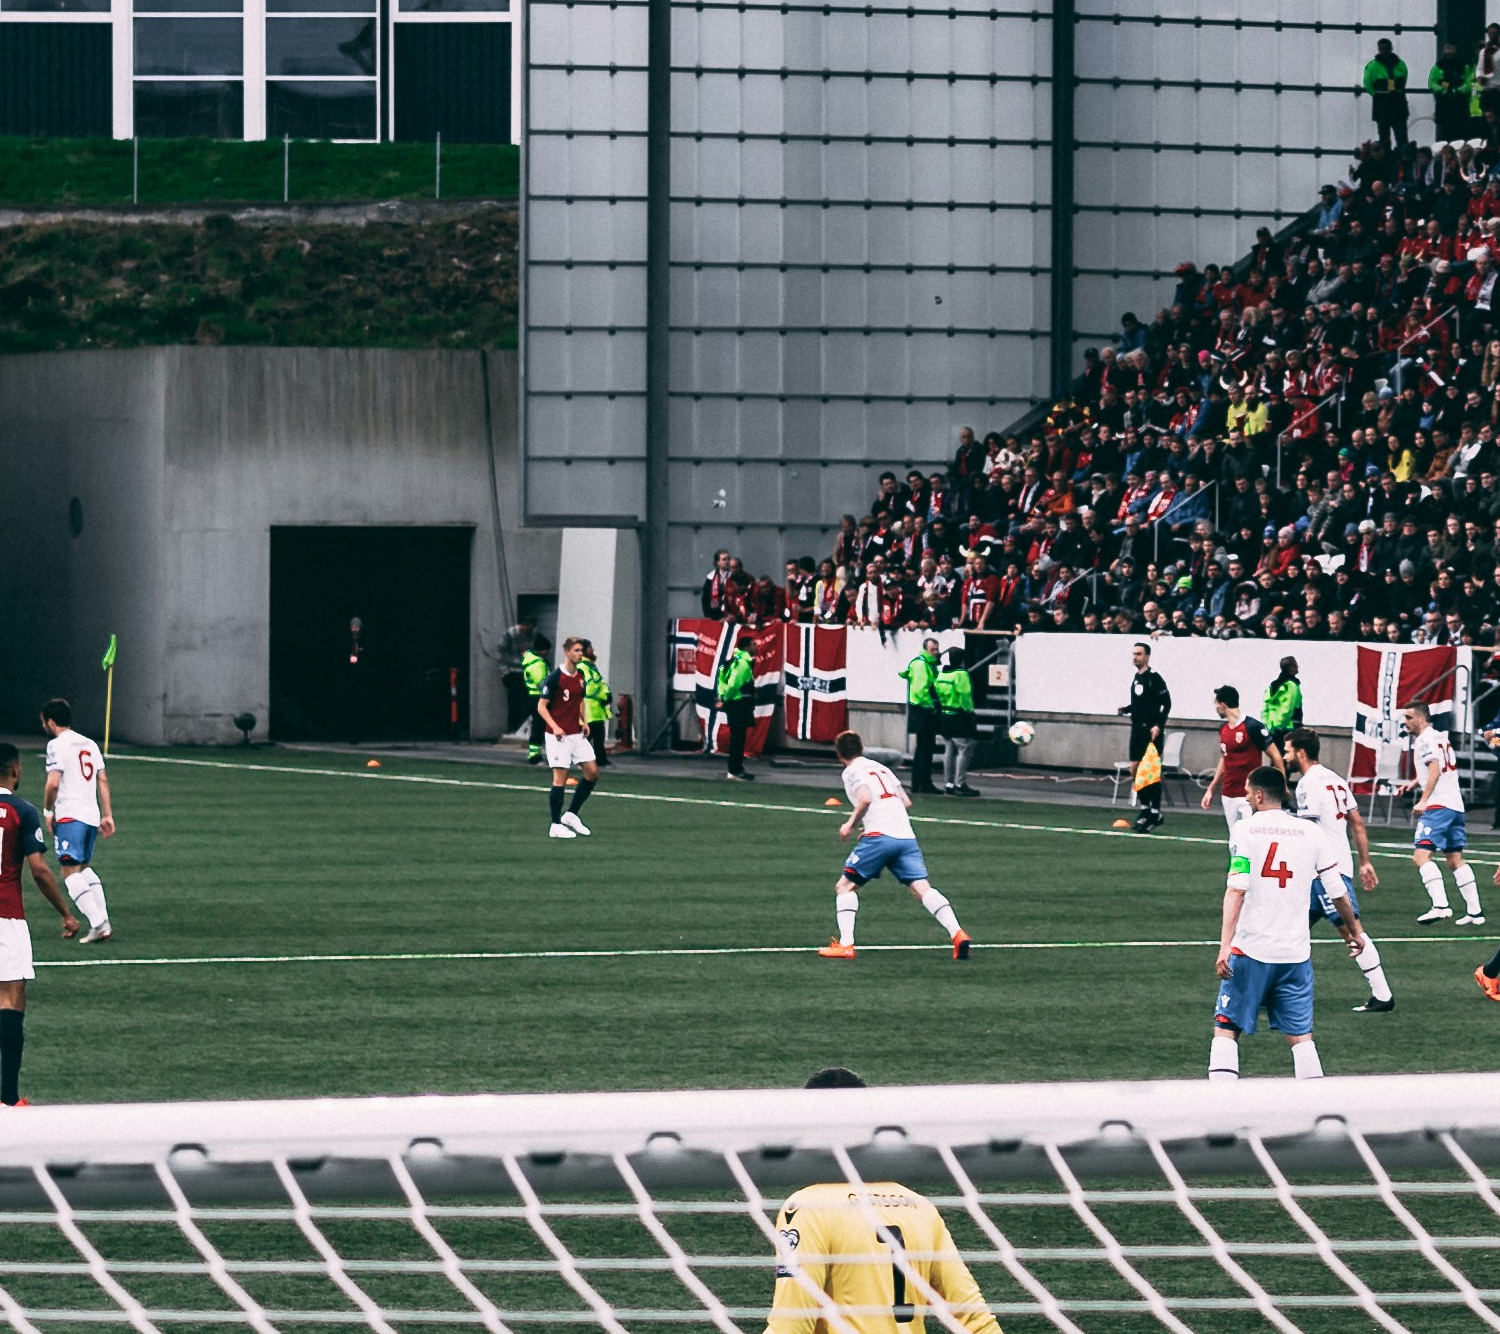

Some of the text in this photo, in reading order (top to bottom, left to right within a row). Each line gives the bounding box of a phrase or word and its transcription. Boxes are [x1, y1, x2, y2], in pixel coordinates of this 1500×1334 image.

[78, 749, 95, 782] 6
[1261, 841, 1294, 889] 4
[875, 1224, 915, 1324] 1
